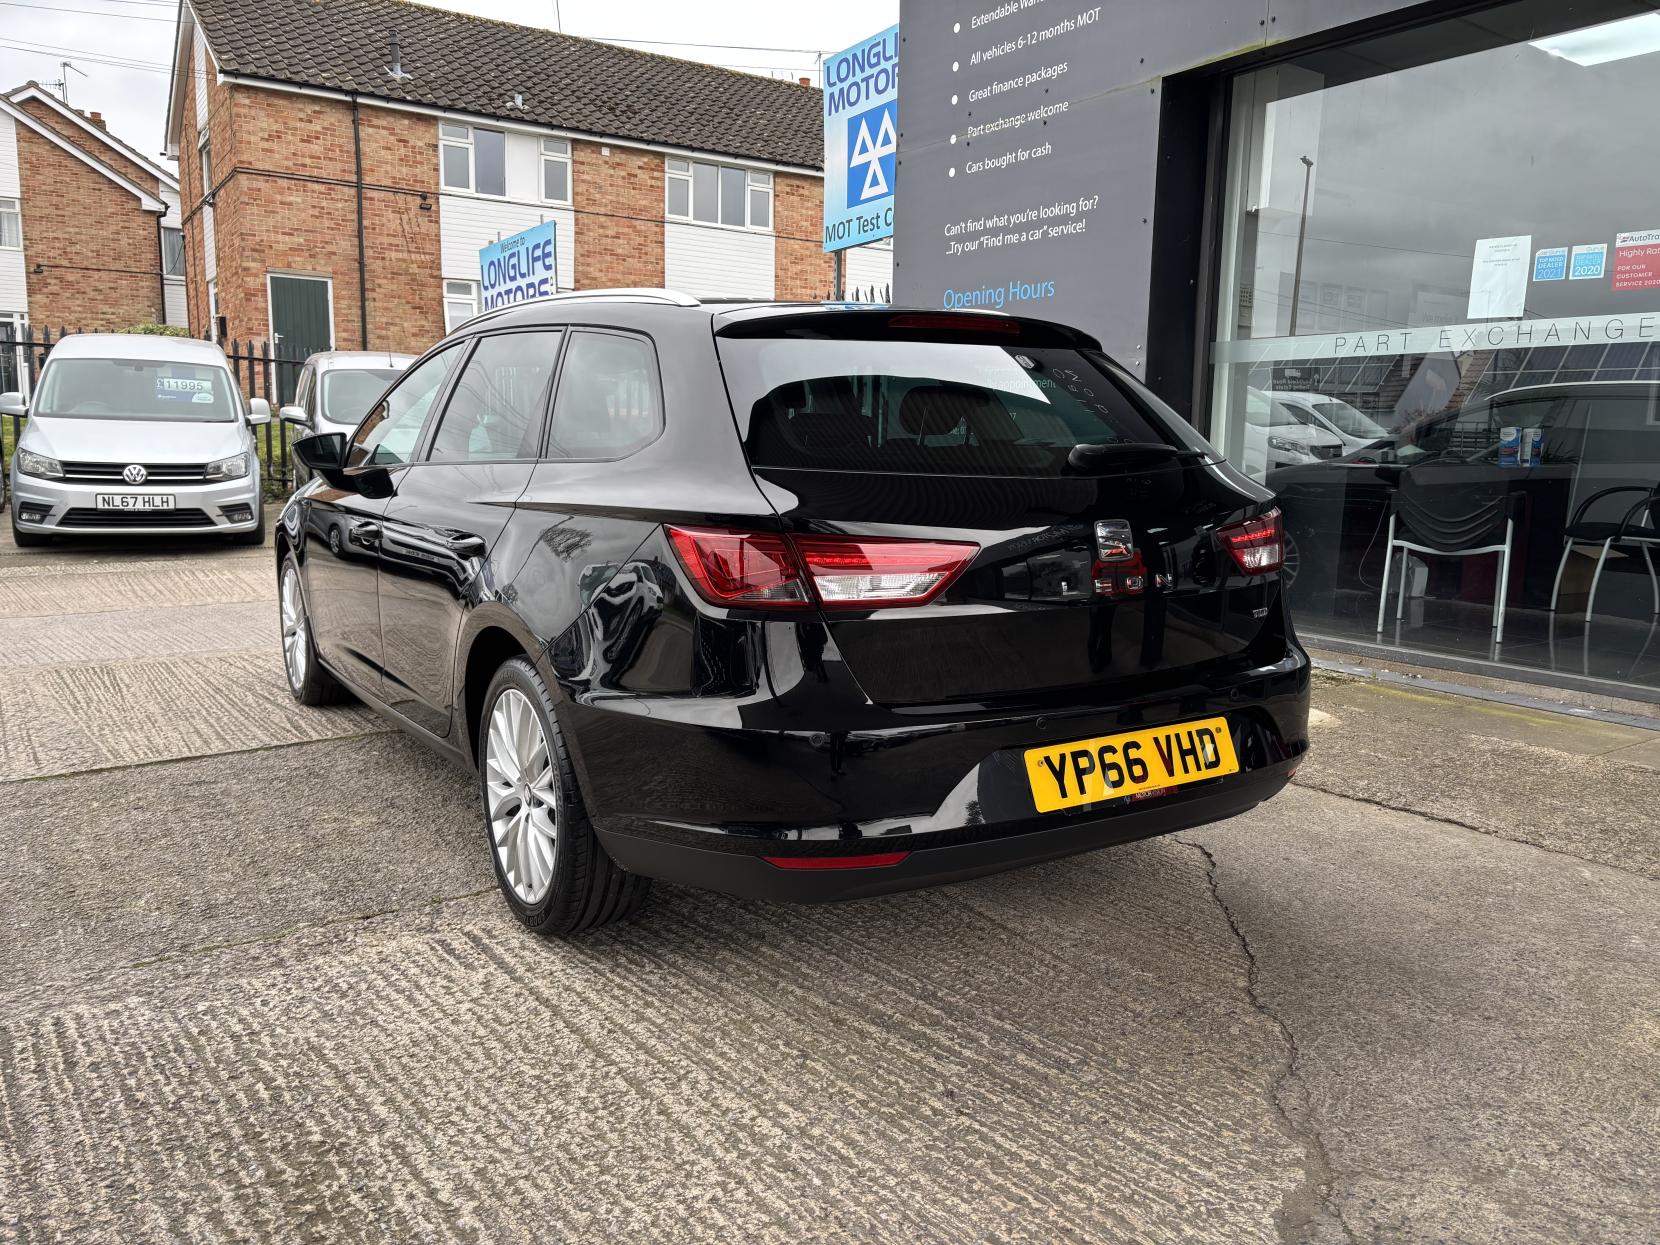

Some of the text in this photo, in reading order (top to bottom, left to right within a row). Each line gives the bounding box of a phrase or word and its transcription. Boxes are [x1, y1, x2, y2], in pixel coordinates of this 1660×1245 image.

[971, 1, 1019, 29] Extendable
[970, 6, 1101, 66] All vehicles 6-12 months MOT
[969, 61, 1068, 102] Great finance packages
[967, 101, 1069, 138] Part exchange welcome
[966, 142, 1052, 174] Cars bought for cash
[825, 218, 853, 243] MOT
[856, 207, 881, 235] Test
[944, 195, 1099, 237] Can't find what you're looking for?
[500, 236, 526, 254] Welcome to
[964, 240, 979, 252] our
[1004, 233, 1020, 245] me
[1021, 232, 1027, 241] a
[1048, 218, 1086, 238] service!
[481, 238, 553, 291] LONGLIFE
[1619, 248, 1644, 258] Highly
[1538, 269, 1561, 278] 2021
[1574, 265, 1600, 276] 2020
[1616, 271, 1653, 279] CUSTOMER
[943, 280, 1055, 309] Opening Hours
[1334, 332, 1412, 354] PART
[1438, 317, 1655, 348] EXCHANGE
[102, 496, 170, 508] NL67 HLH
[1043, 727, 1221, 799] YP66 VHD
